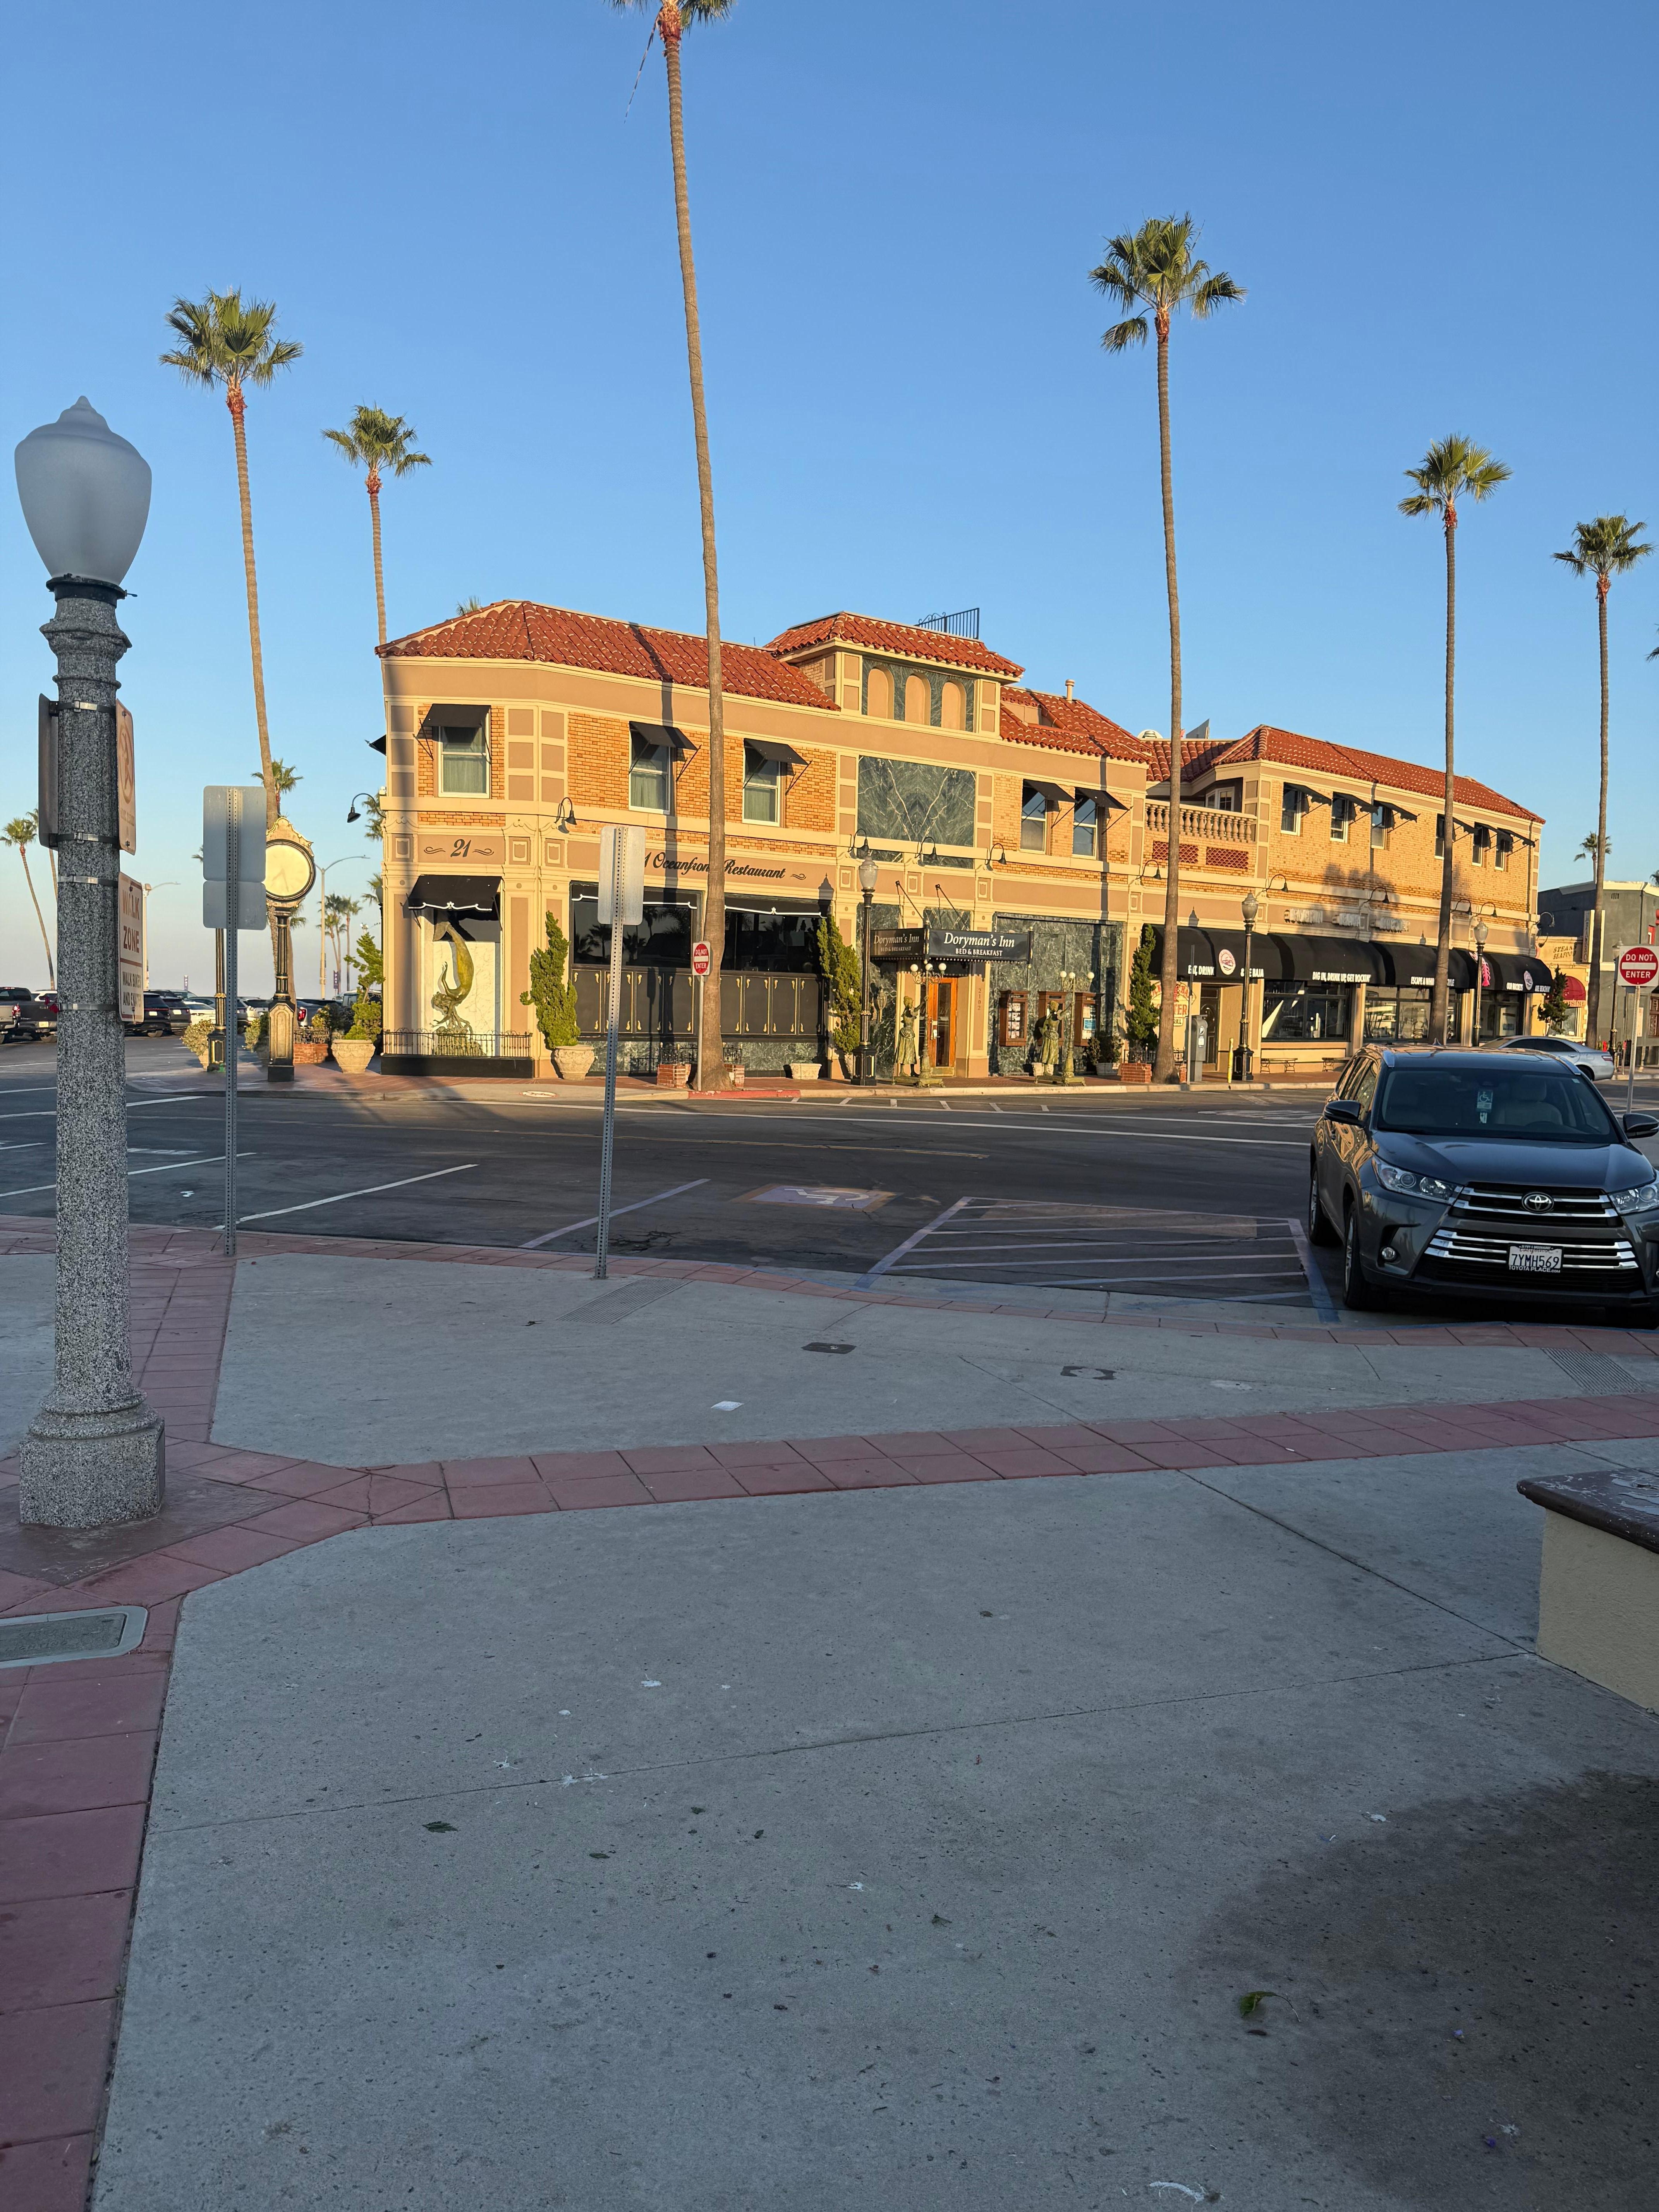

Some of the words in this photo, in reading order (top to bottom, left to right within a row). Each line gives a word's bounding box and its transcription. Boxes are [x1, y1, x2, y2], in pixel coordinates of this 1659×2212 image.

[450, 839, 471, 857] 21
[653, 852, 709, 874] Oceanfron
[724, 859, 786, 879] Restaurant
[122, 889, 140, 920] WALK
[123, 925, 140, 953] ZONE
[874, 934, 907, 946] Doryman's
[909, 934, 919, 943] Inn
[944, 933, 996, 948] Doryman's
[999, 936, 1015, 948] Inn
[122, 971, 132, 987] WALK
[1198, 966, 1215, 975] DRINK
[1252, 969, 1264, 977] BAJA
[1312, 971, 1321, 980] DIG
[1327, 972, 1340, 981] DRINK
[1411, 976, 1423, 985] ESCAPE
[1511, 1254, 1559, 1268] 7YMH569
